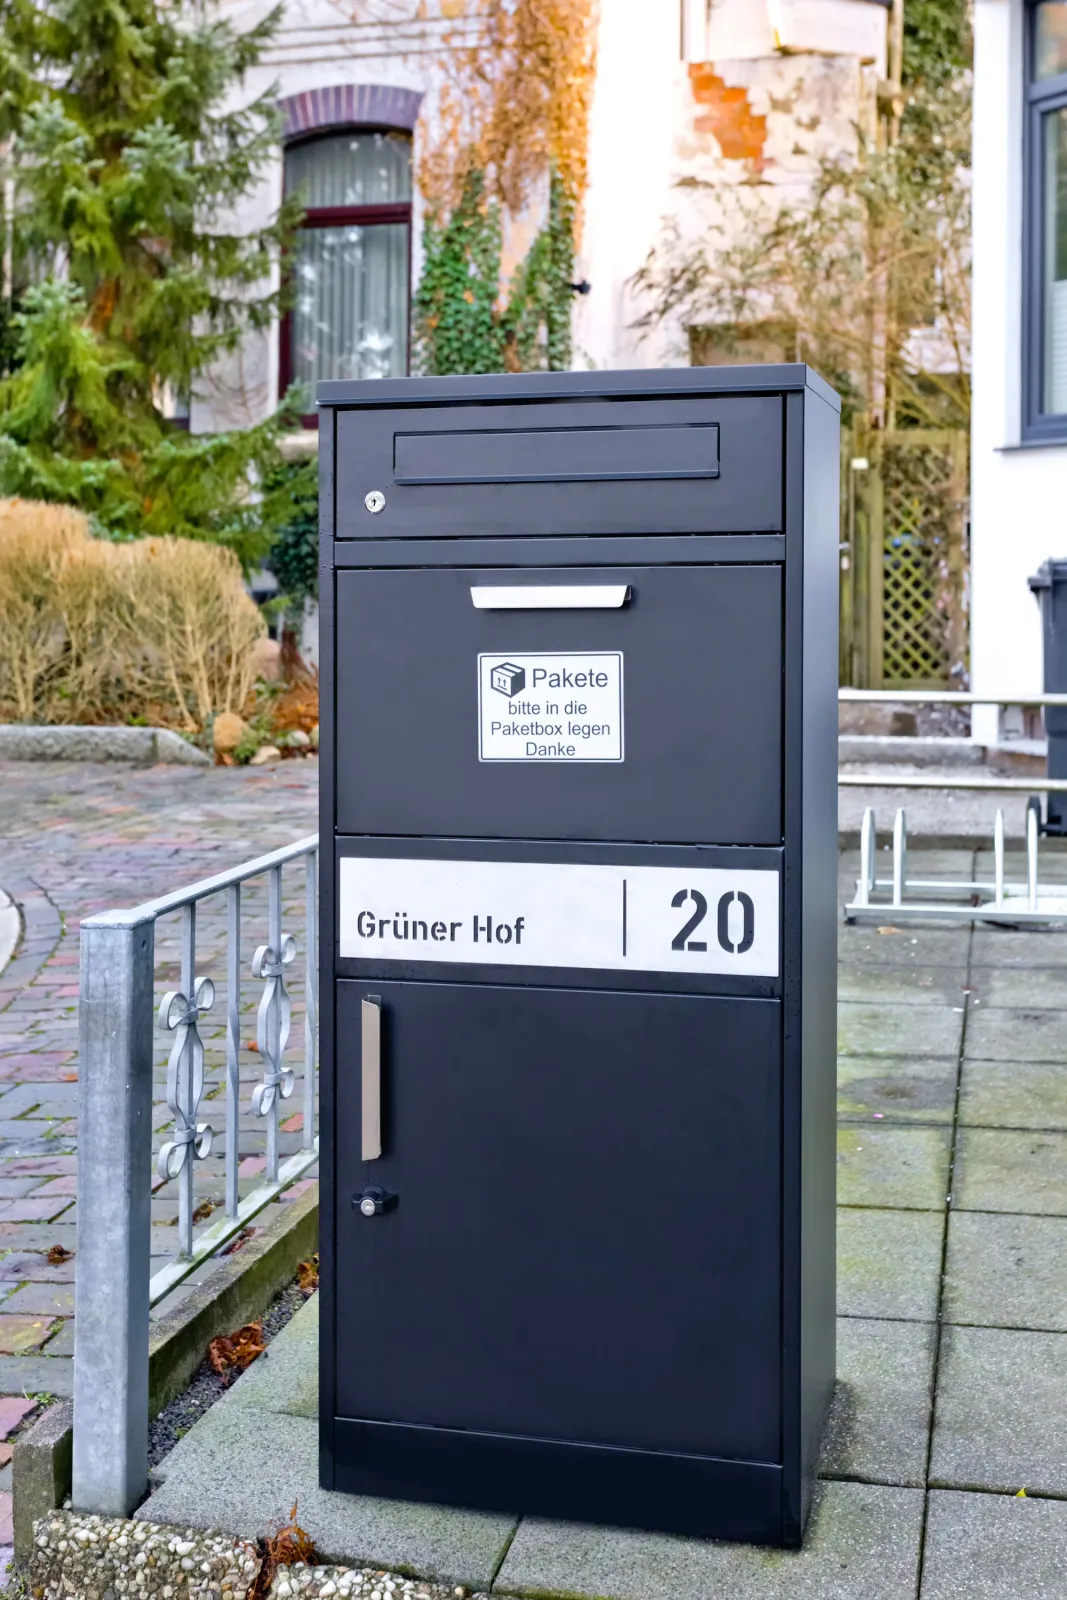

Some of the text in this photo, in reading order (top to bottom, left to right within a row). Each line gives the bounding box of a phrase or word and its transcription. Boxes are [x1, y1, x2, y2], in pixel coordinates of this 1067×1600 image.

[532, 668, 609, 688] Pakete
[508, 700, 588, 715] bitte in die
[491, 721, 611, 739] Paketbox legen
[526, 742, 576, 756] Danke
[356, 910, 525, 945] Grüner Hof
[670, 888, 755, 954] 20
